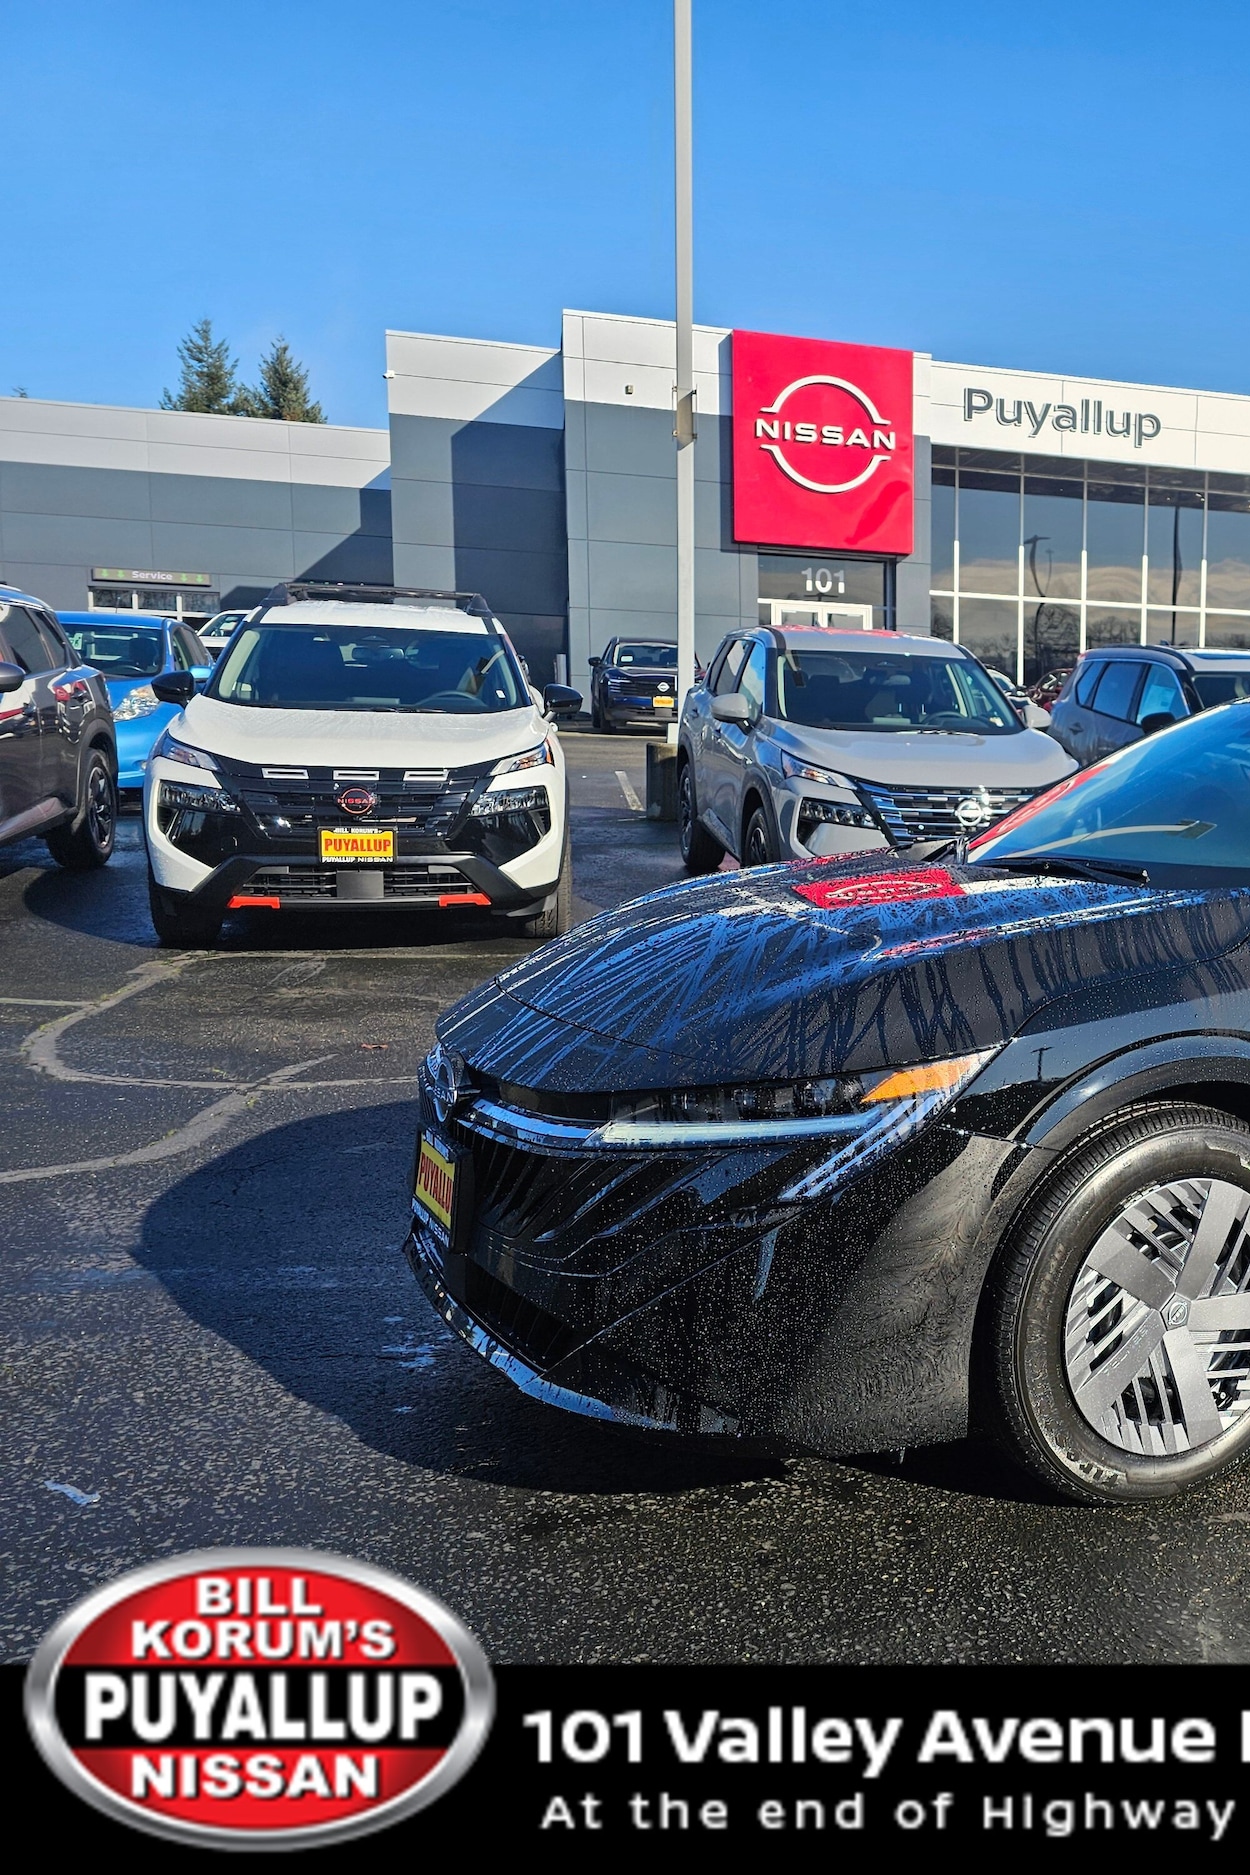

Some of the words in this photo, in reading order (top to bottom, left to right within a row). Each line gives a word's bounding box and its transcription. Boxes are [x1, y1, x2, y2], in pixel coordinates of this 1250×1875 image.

[756, 416, 896, 452] NISSAN
[963, 387, 1161, 449] Puyallup
[131, 570, 173, 580] Service
[801, 566, 846, 594] 101
[324, 838, 391, 852] PUYALLUP
[419, 1152, 453, 1214] PUYALLU
